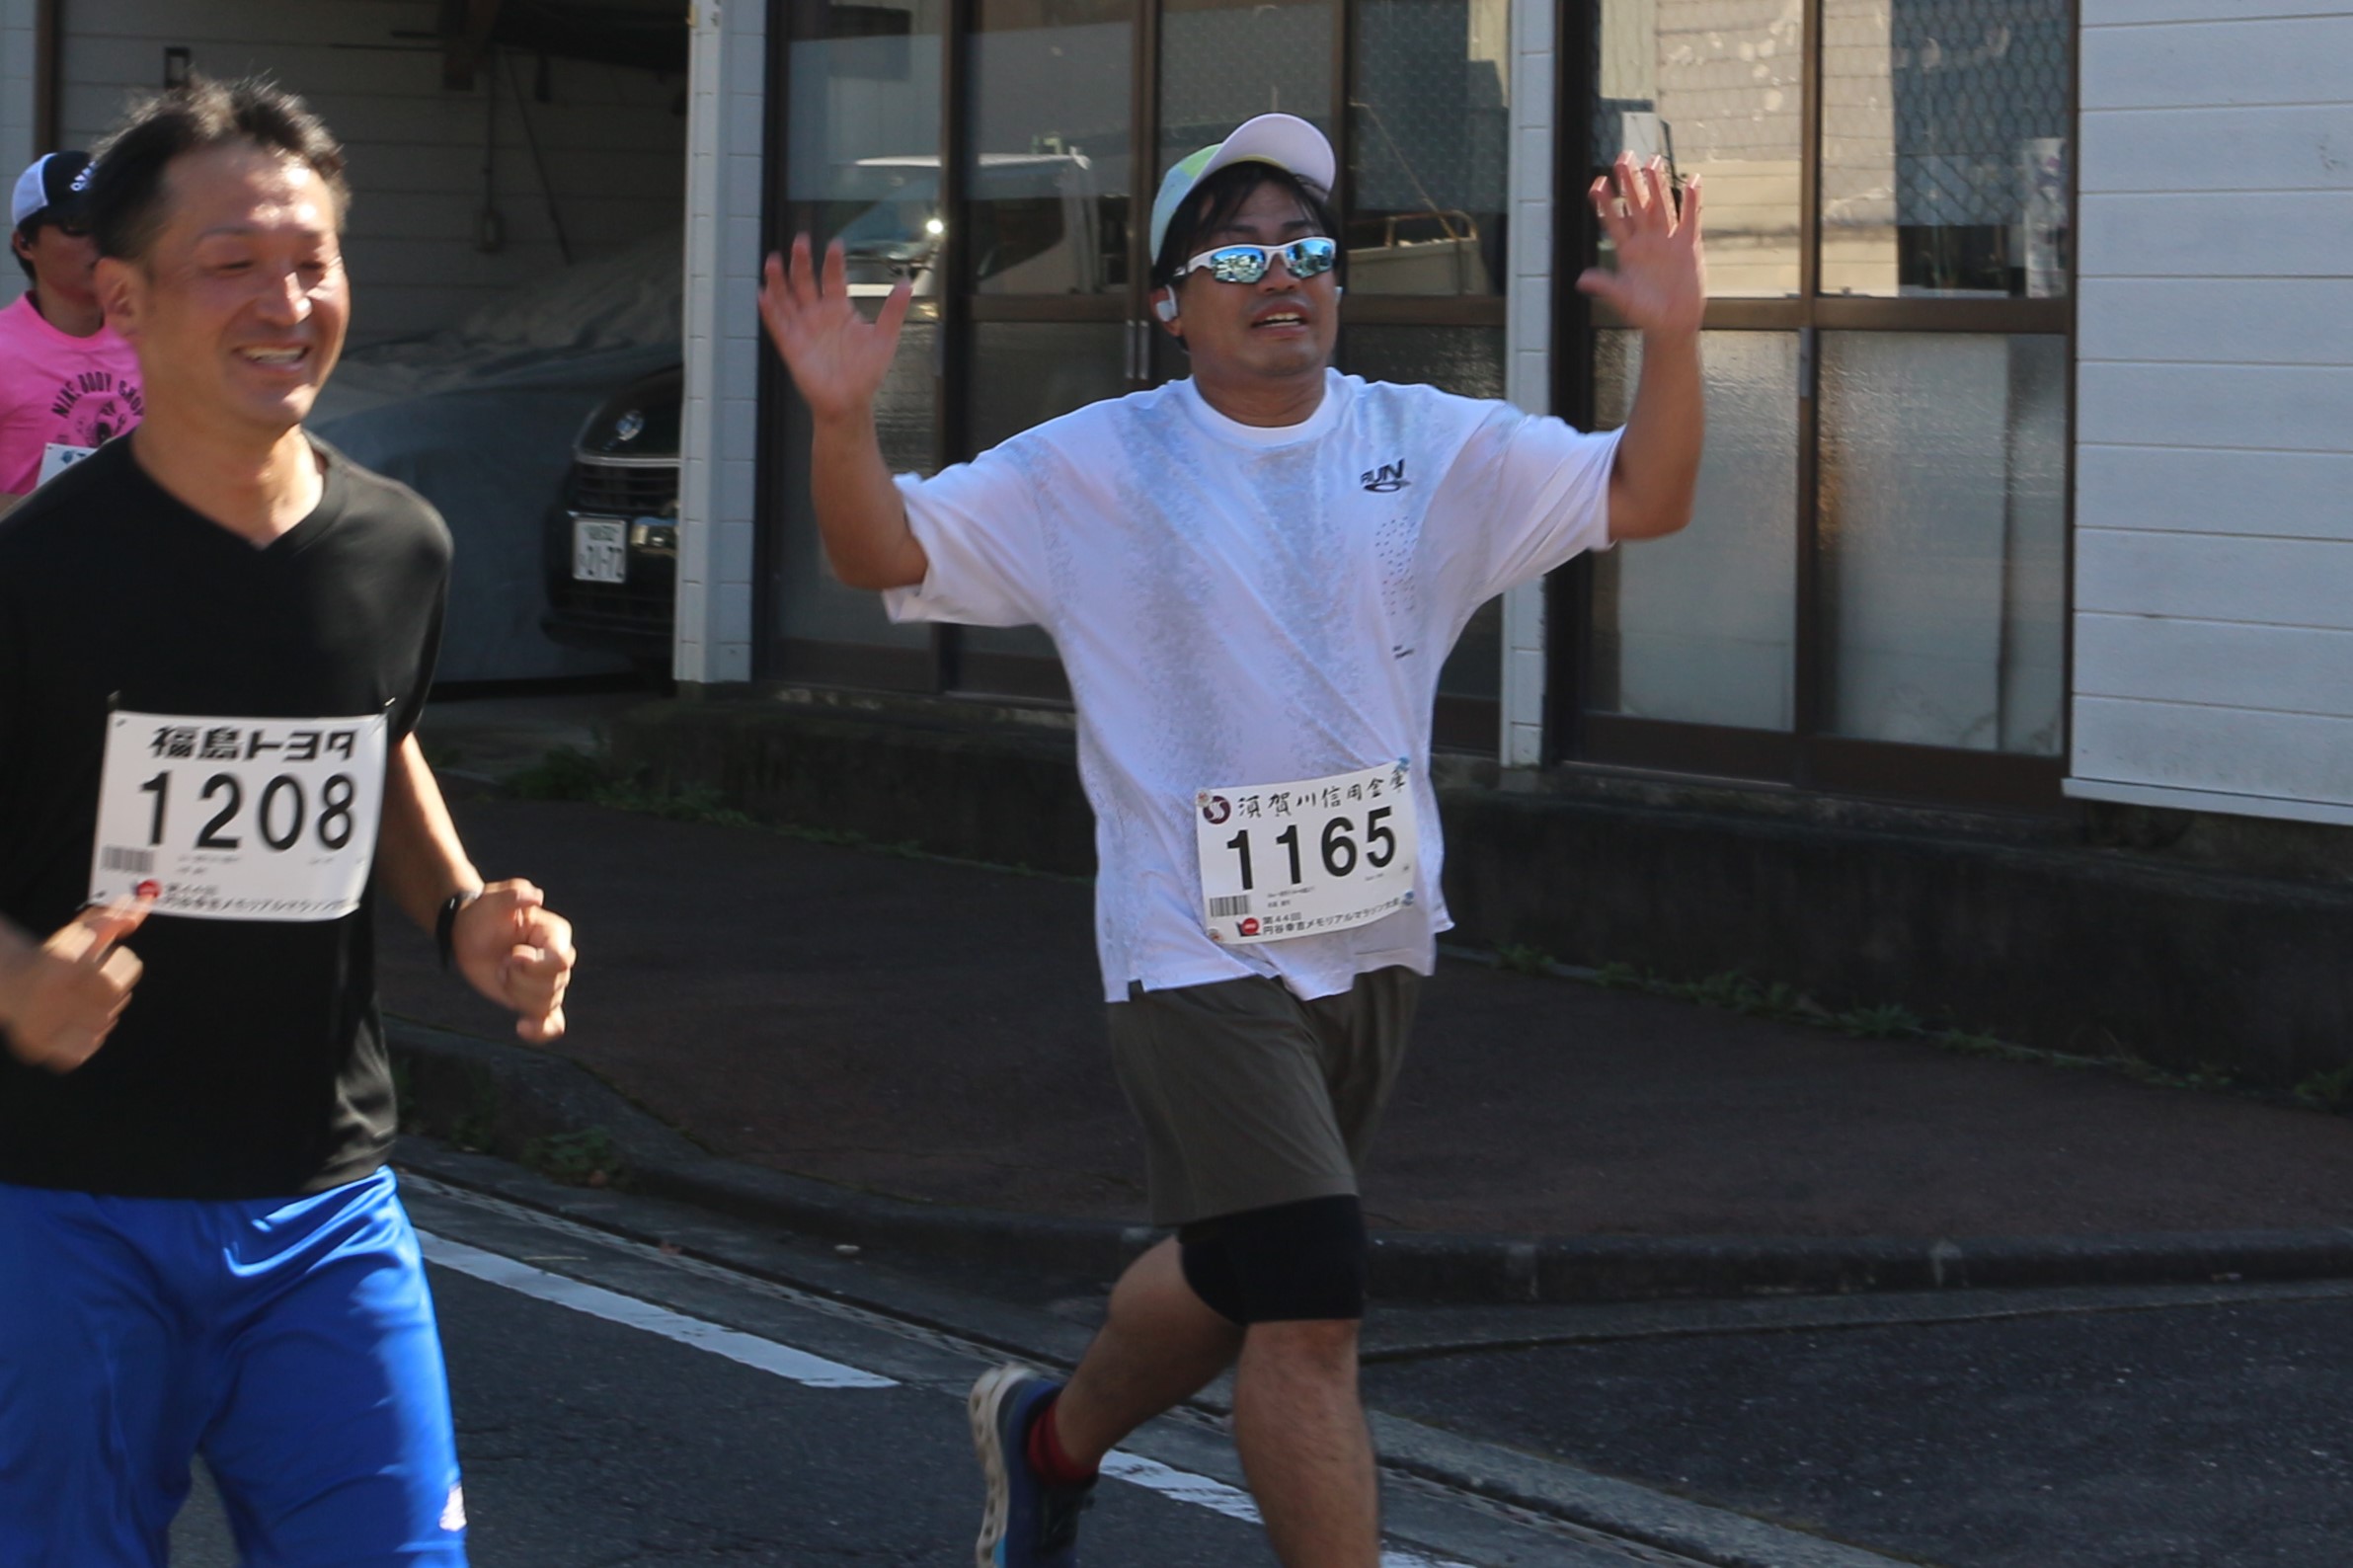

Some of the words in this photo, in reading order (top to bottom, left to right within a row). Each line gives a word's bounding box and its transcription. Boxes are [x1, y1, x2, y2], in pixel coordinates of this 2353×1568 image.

[77, 371, 113, 394] BODY
[147, 725, 359, 762] 福島トヨタ
[137, 769, 355, 851] 1208
[1226, 805, 1396, 891] 1165
[1262, 911, 1302, 925] 第44回
